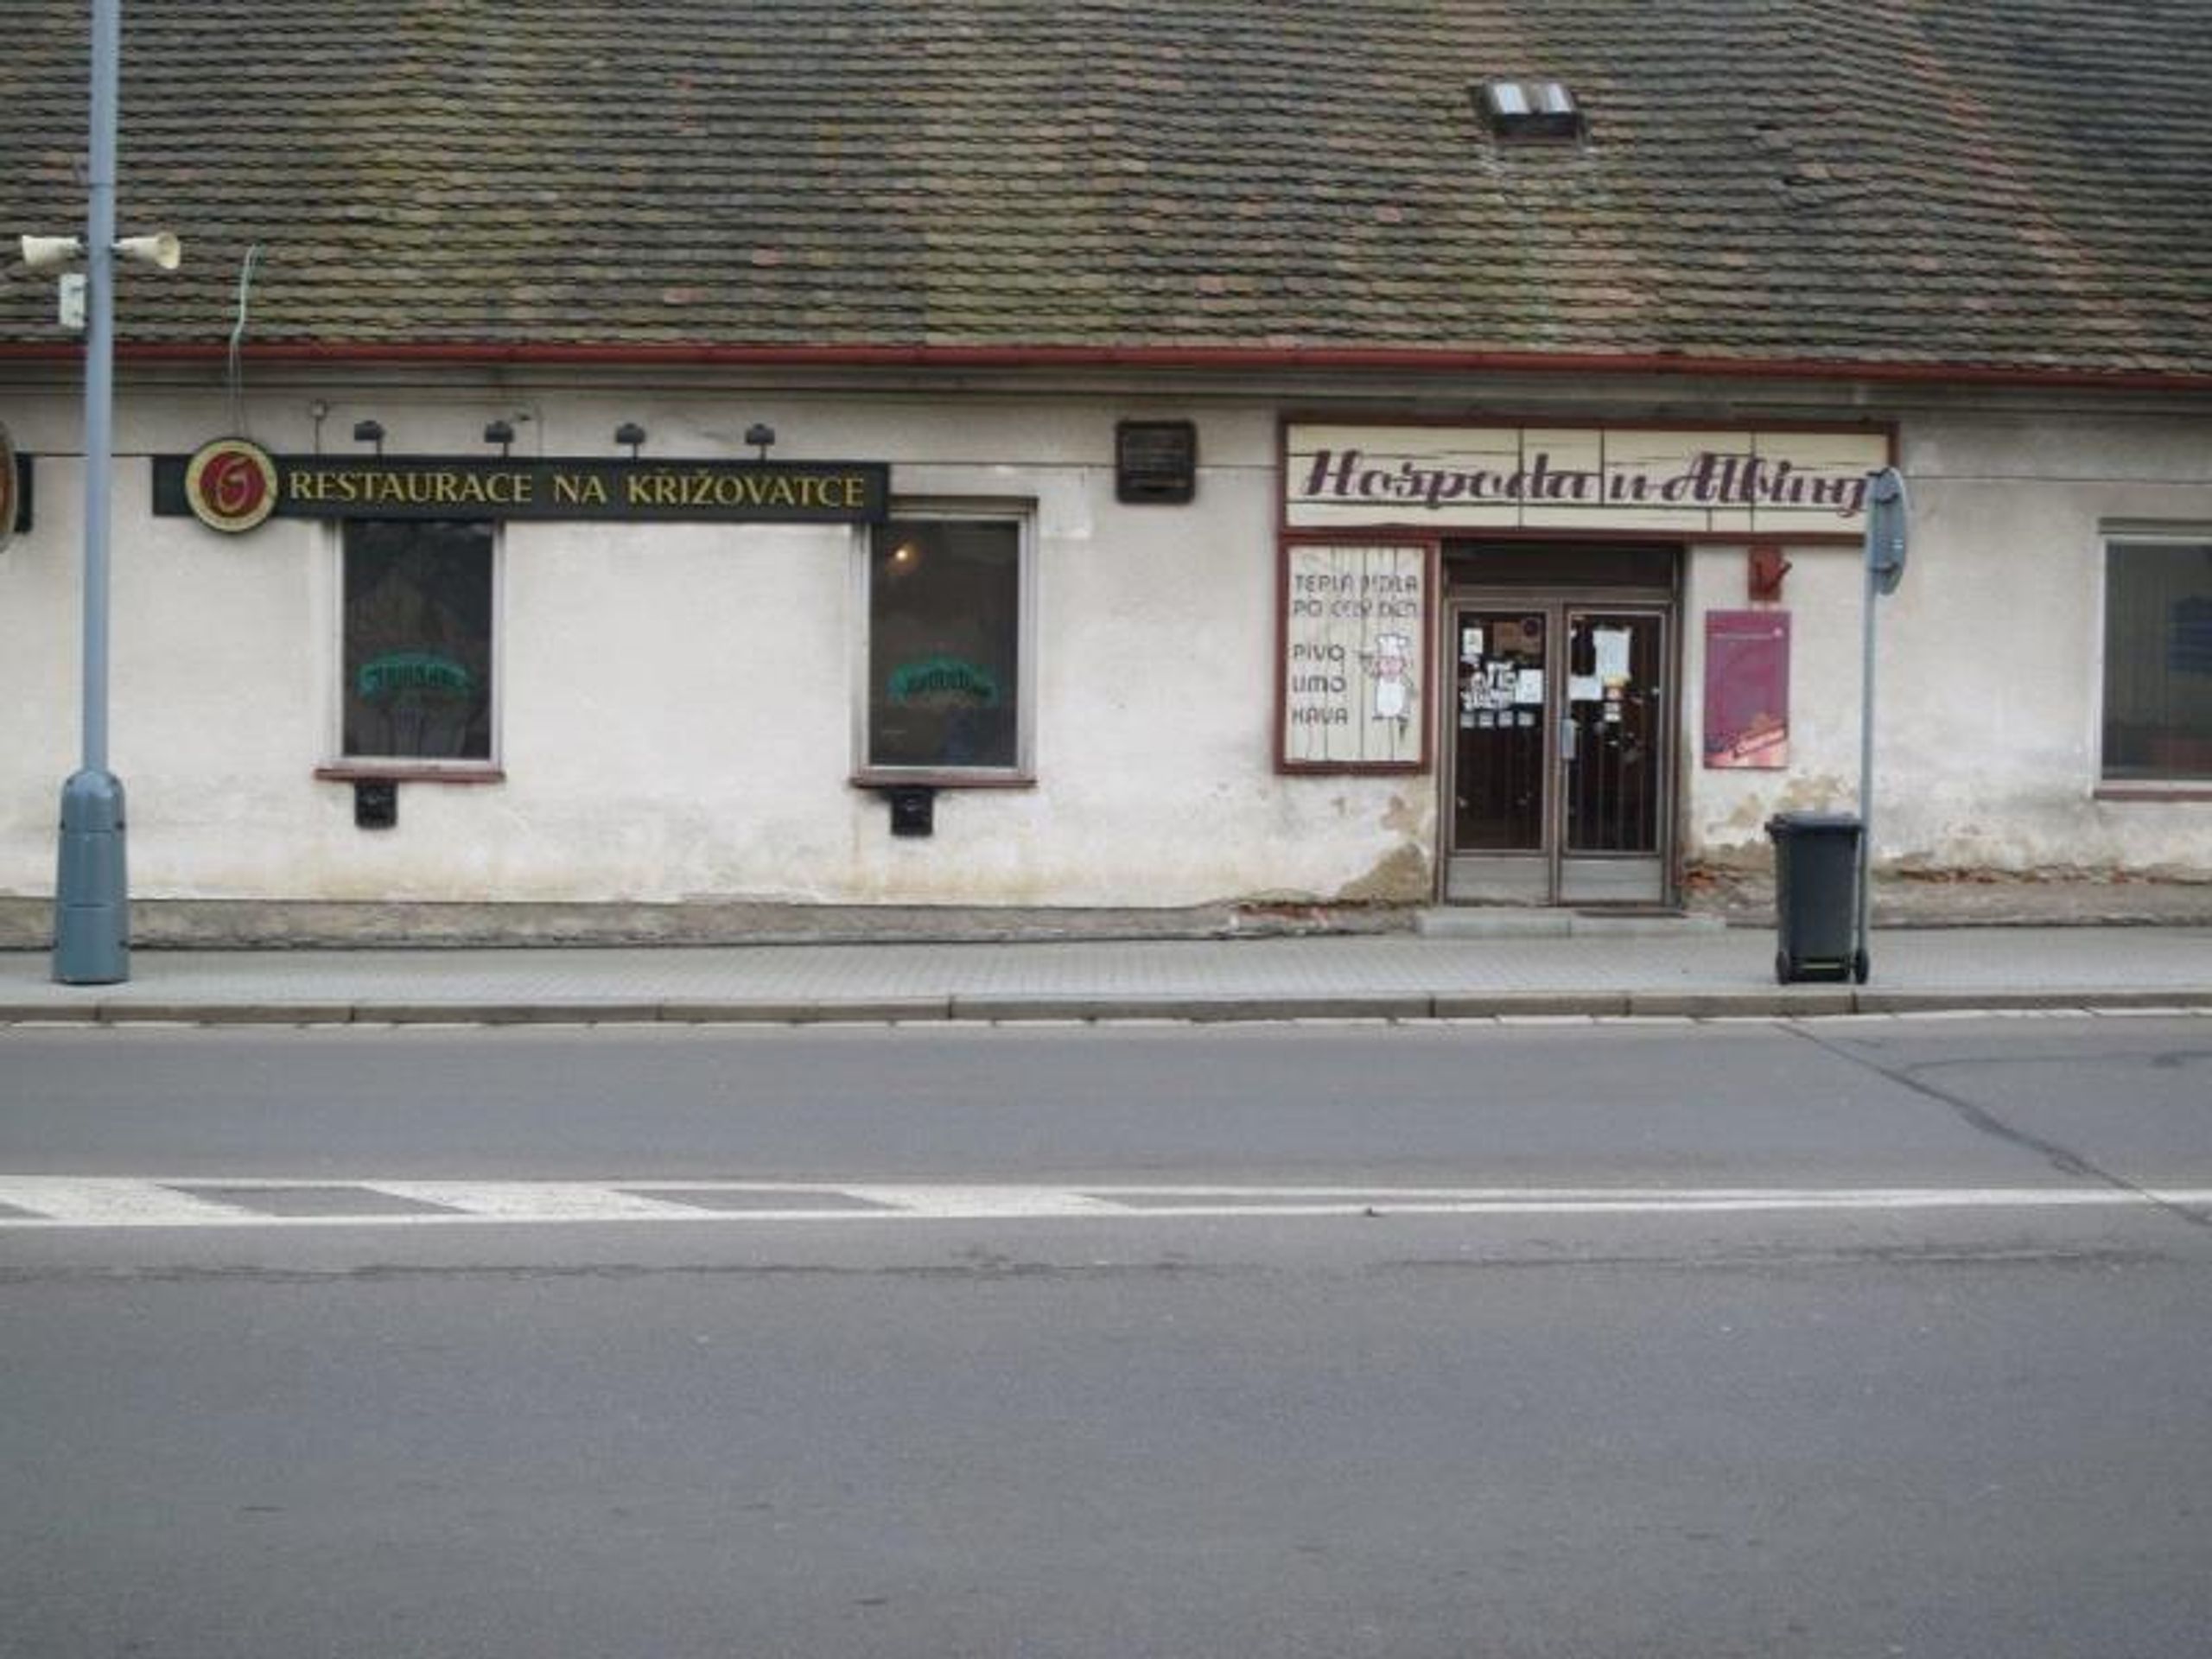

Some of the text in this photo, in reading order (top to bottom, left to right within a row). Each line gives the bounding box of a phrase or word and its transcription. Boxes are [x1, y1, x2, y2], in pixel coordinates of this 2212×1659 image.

[289, 467, 865, 508] RESTAURACE NA KŘIŽOVATCE
[1305, 449, 1595, 510] Hospoda
[1294, 644, 1345, 662] PIVO
